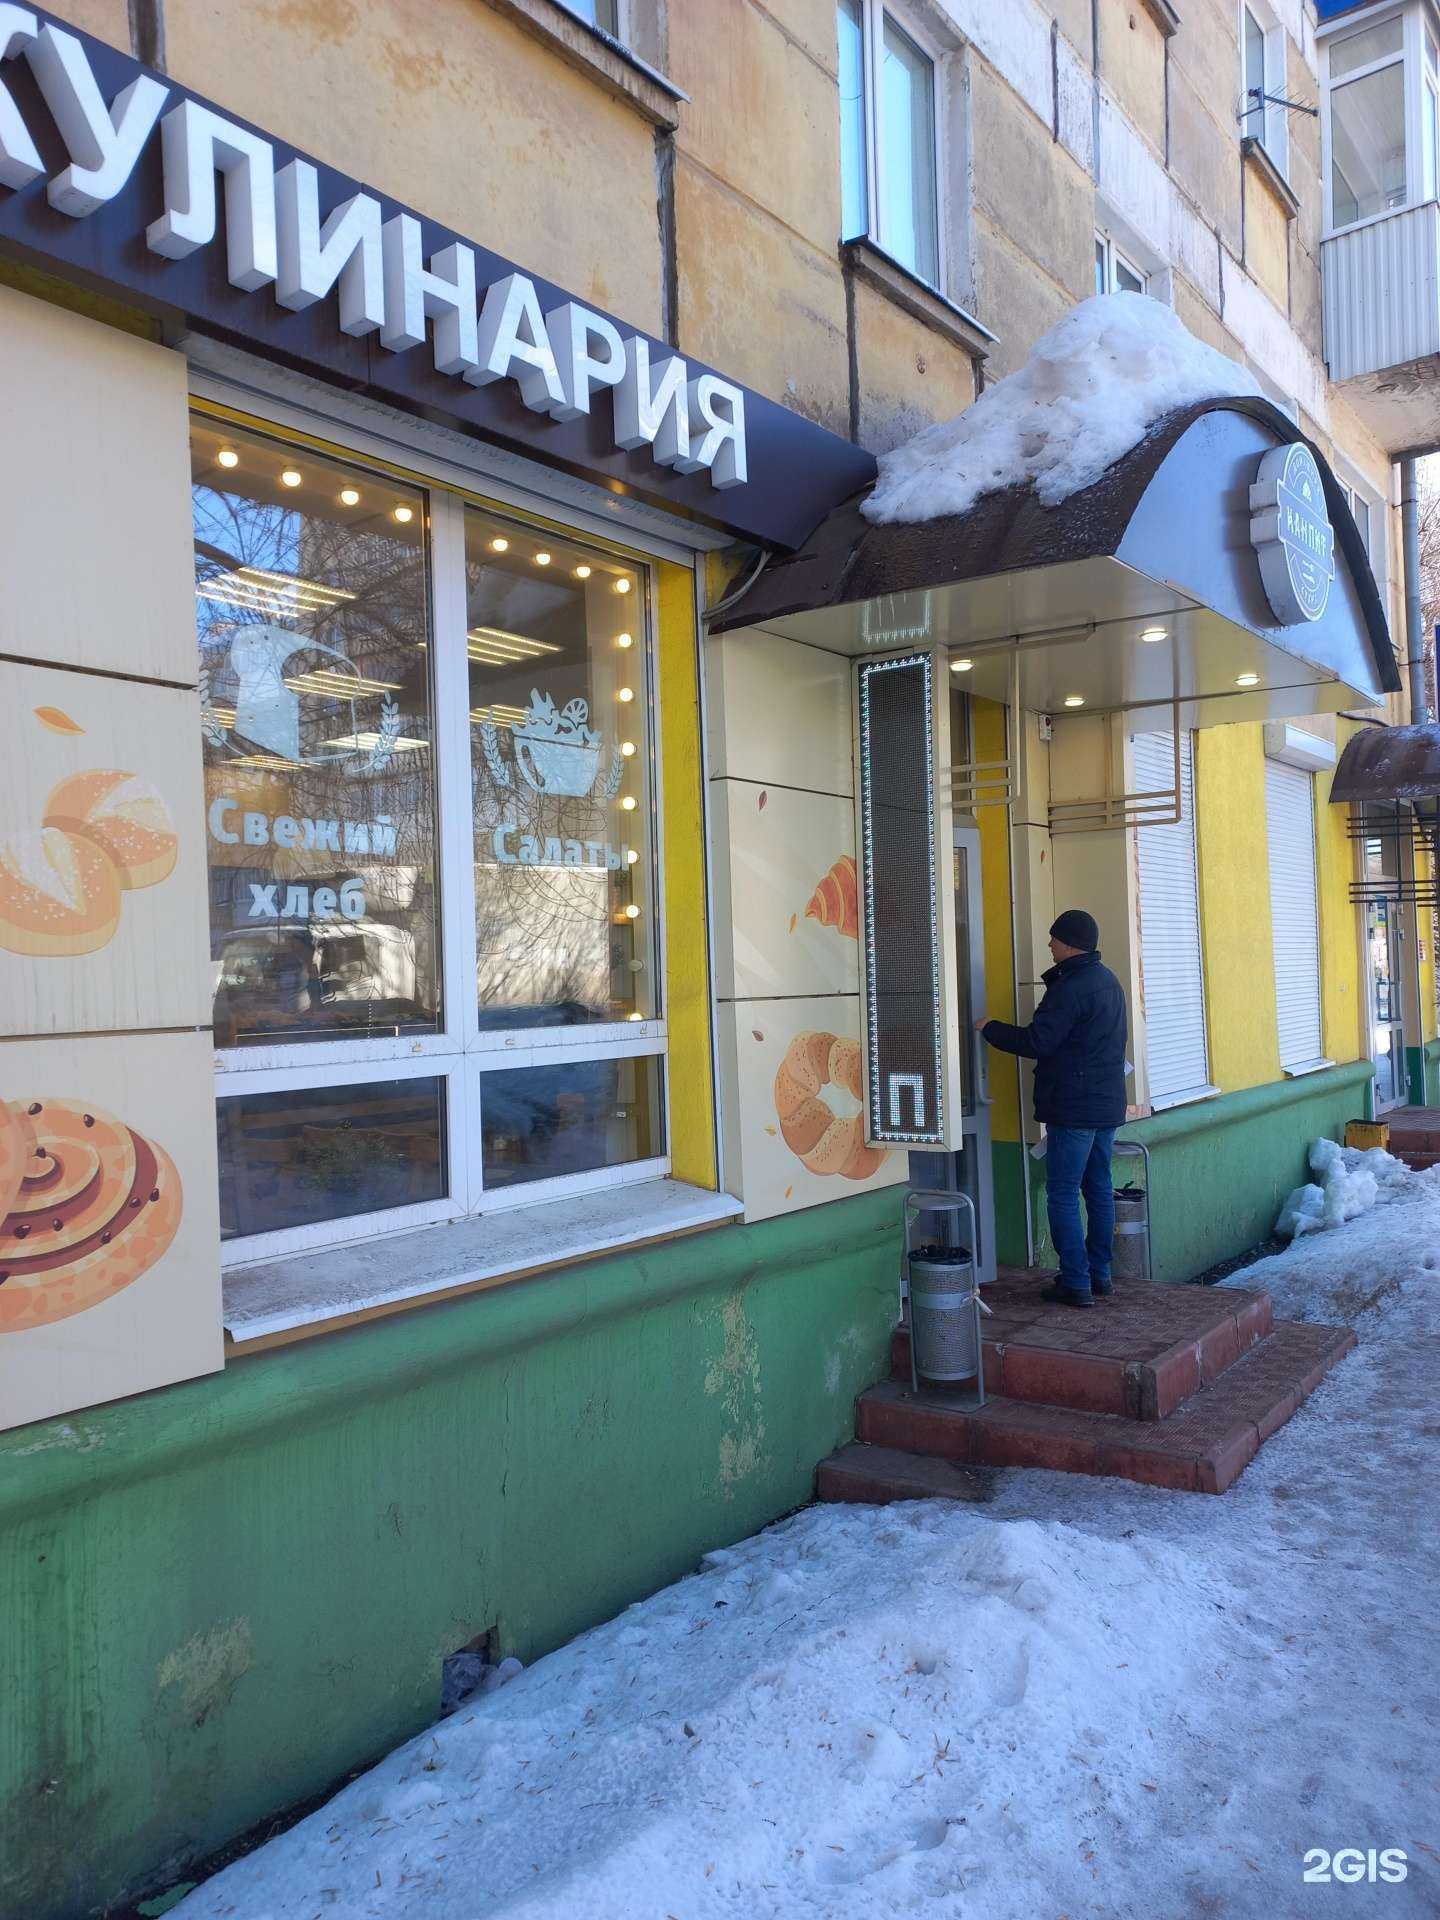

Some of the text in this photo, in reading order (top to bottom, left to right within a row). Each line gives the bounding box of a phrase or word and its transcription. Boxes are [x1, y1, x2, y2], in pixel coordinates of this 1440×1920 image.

[208, 798, 398, 856] Свежий
[492, 822, 629, 871] Салаты
[248, 877, 367, 920] хлеб
